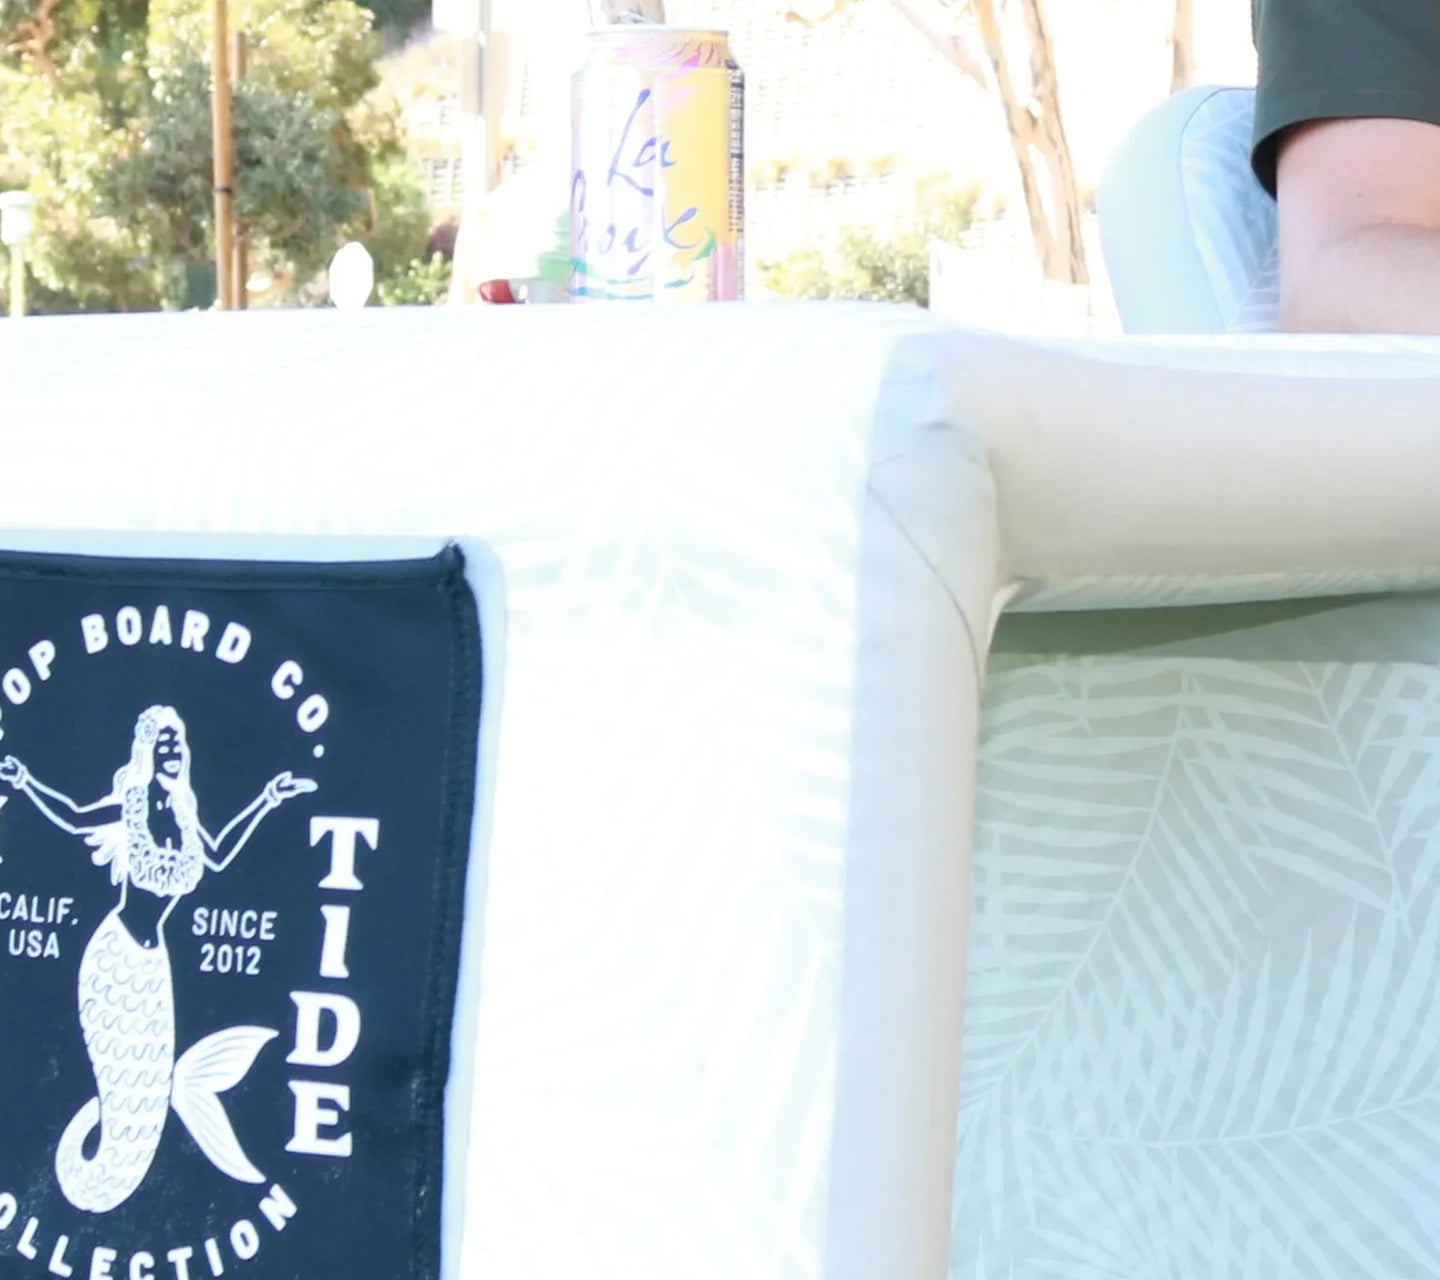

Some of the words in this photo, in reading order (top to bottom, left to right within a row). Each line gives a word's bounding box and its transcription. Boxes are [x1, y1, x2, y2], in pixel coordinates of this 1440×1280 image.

[80, 605, 252, 664] BOARD
[270, 660, 331, 758] CO.
[191, 907, 277, 942] SINCE
[8, 930, 60, 960] USA
[199, 944, 262, 976] 2012
[286, 817, 379, 1157] TIDE
